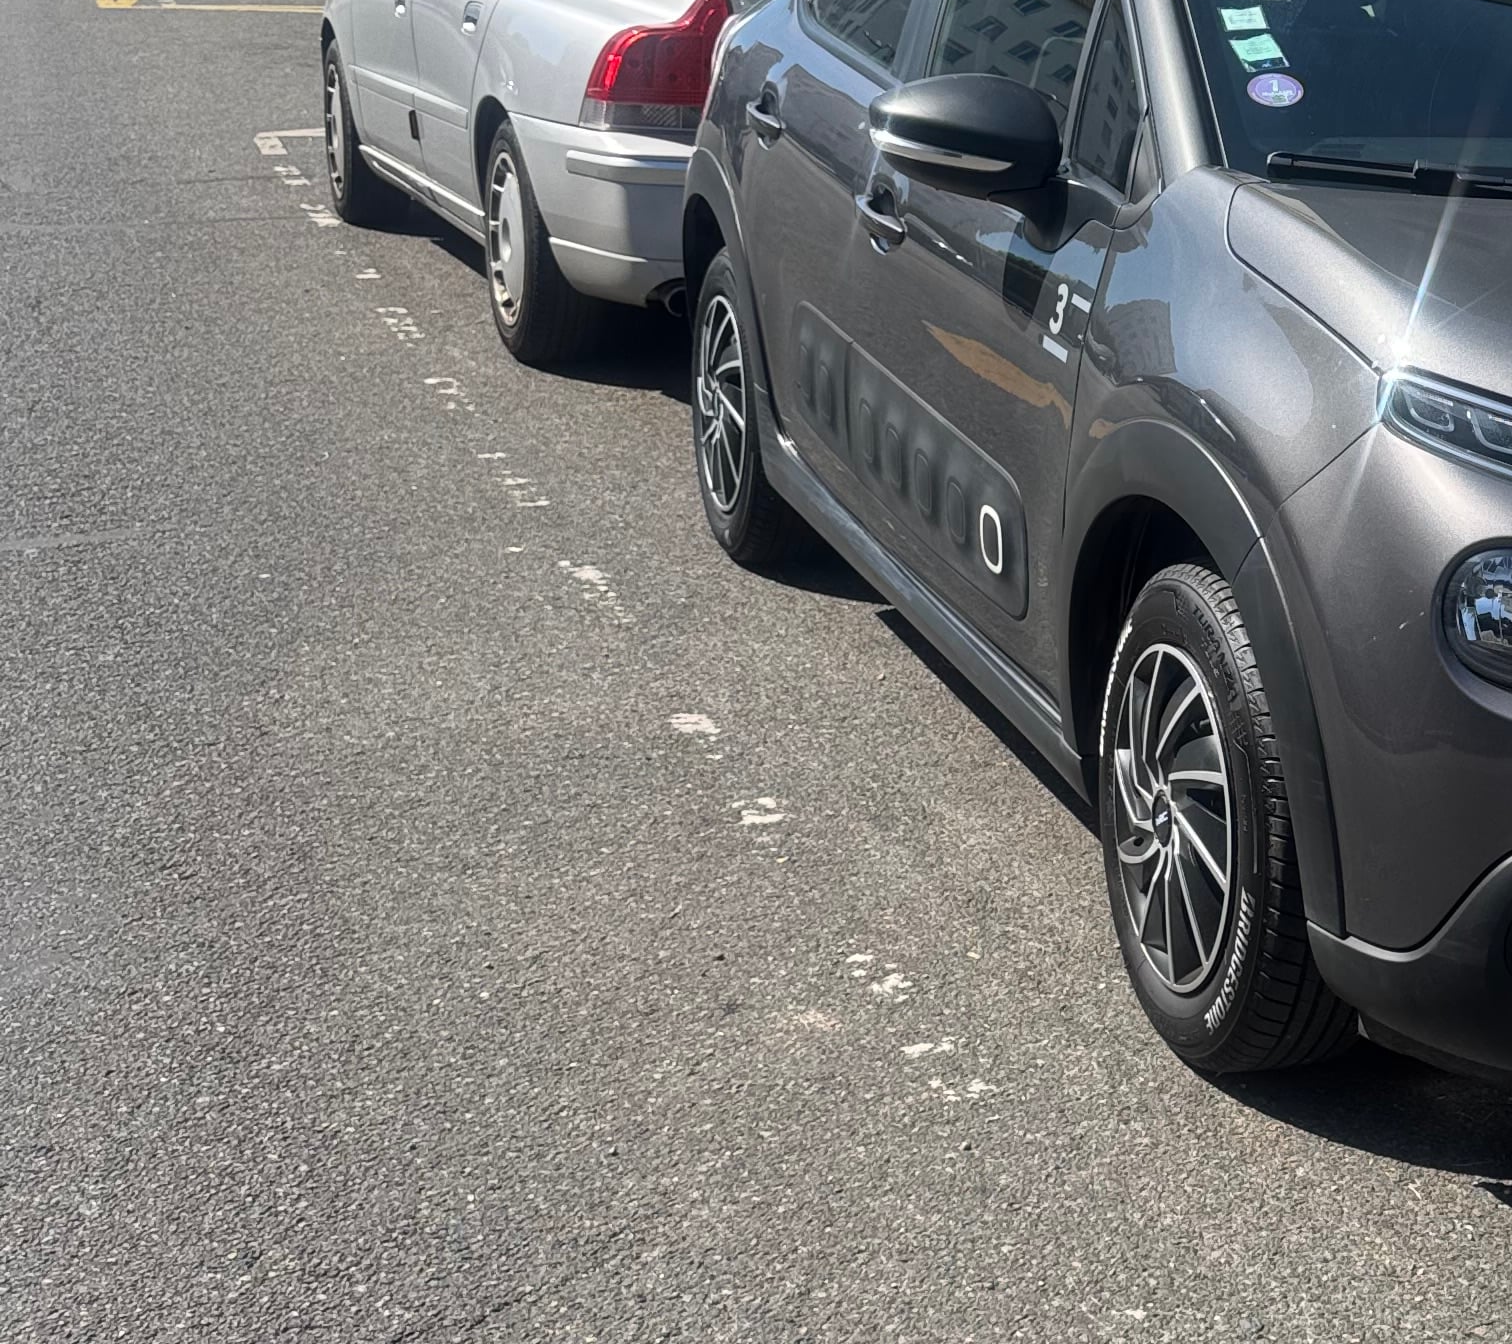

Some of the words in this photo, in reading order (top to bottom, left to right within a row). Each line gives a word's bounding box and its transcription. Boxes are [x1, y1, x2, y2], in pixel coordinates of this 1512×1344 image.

[1049, 283, 1069, 334] 3
[1192, 604, 1239, 704] TURANZA
[1203, 885, 1256, 1036] BRIDGESTONE
